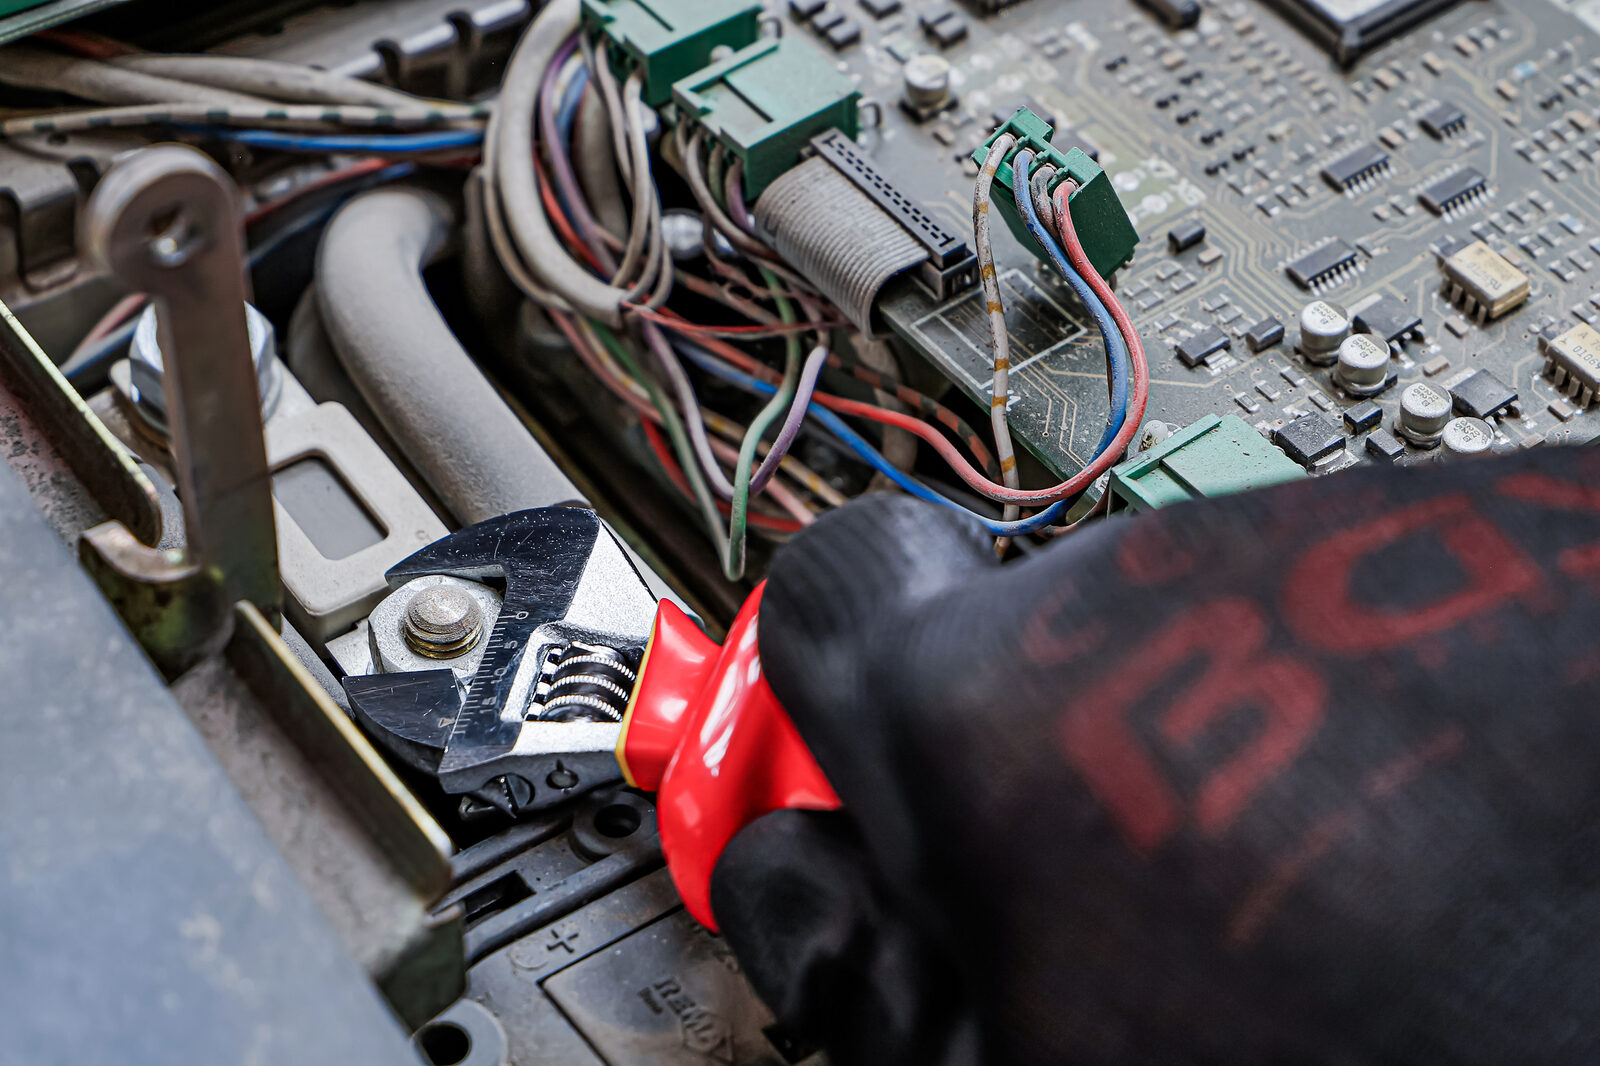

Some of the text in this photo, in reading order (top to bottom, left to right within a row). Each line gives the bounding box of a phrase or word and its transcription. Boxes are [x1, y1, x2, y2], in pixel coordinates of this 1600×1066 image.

[515, 611, 529, 620] 0
[503, 640, 518, 650] 5
[490, 667, 507, 684] 10
[479, 696, 498, 714] 15
